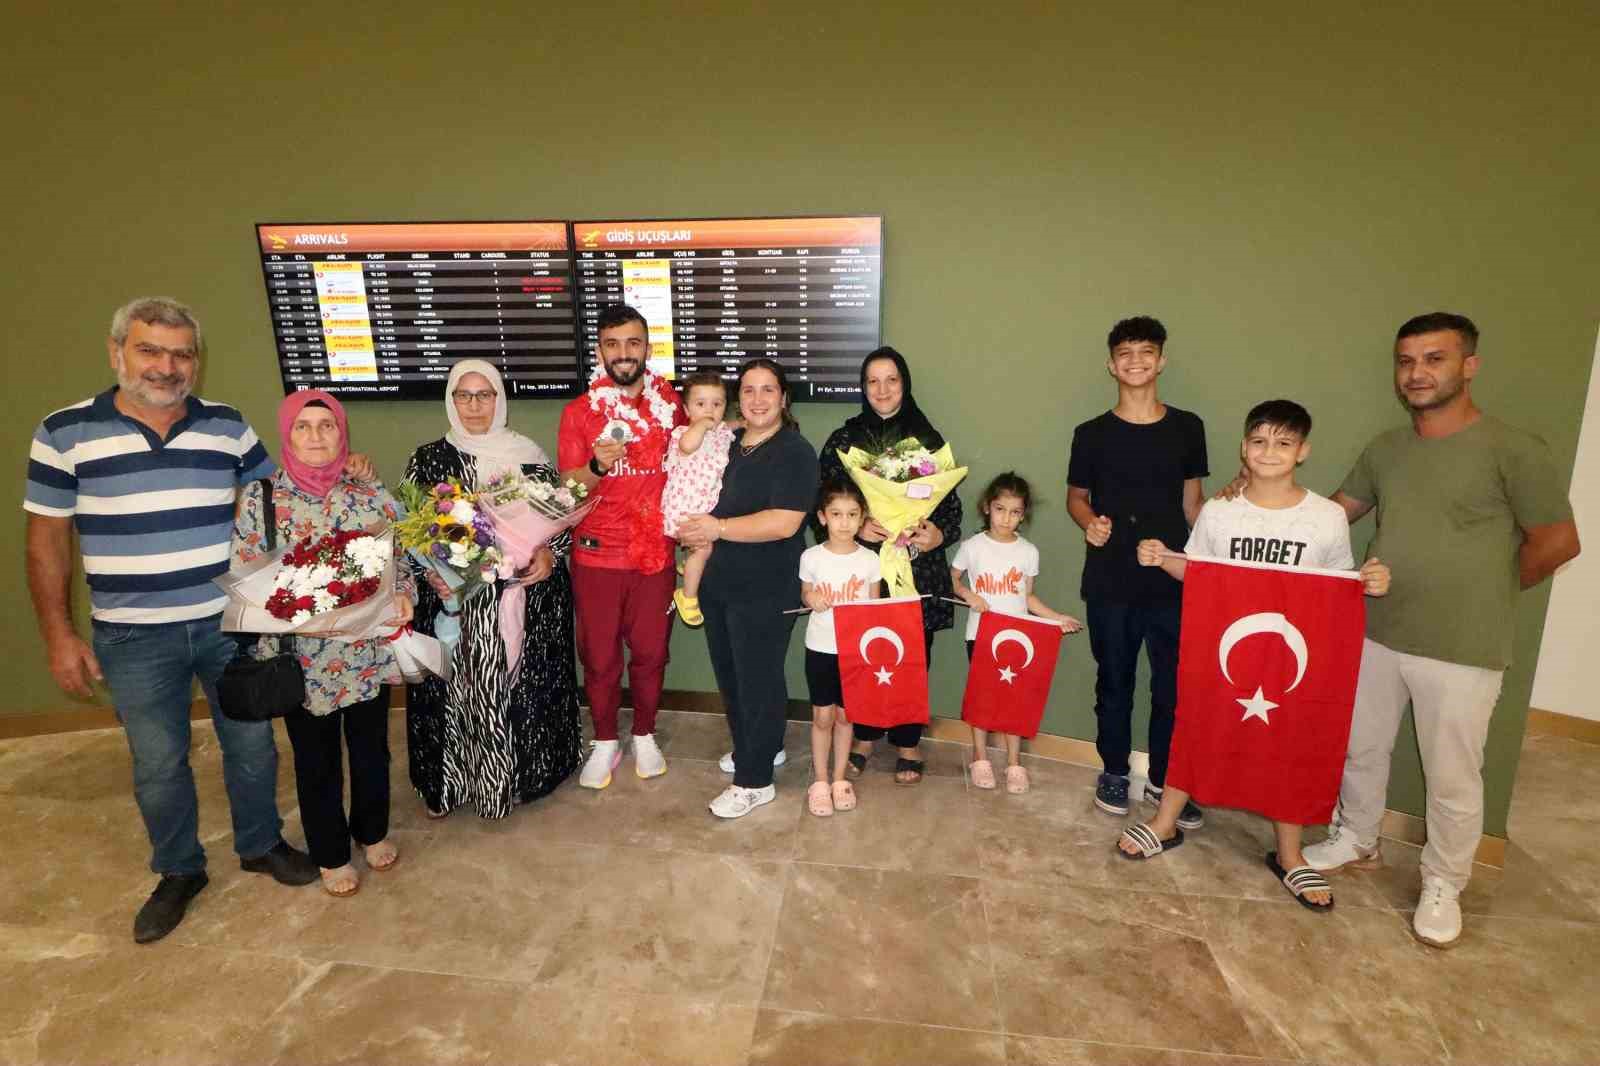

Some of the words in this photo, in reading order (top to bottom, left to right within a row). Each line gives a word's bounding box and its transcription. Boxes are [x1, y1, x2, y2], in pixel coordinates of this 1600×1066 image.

[294, 233, 348, 245] ARRIVALS
[606, 228, 635, 244] GİDİŞ
[638, 230, 692, 244] UÇUŞLARI
[1229, 537, 1307, 566] FORGET
